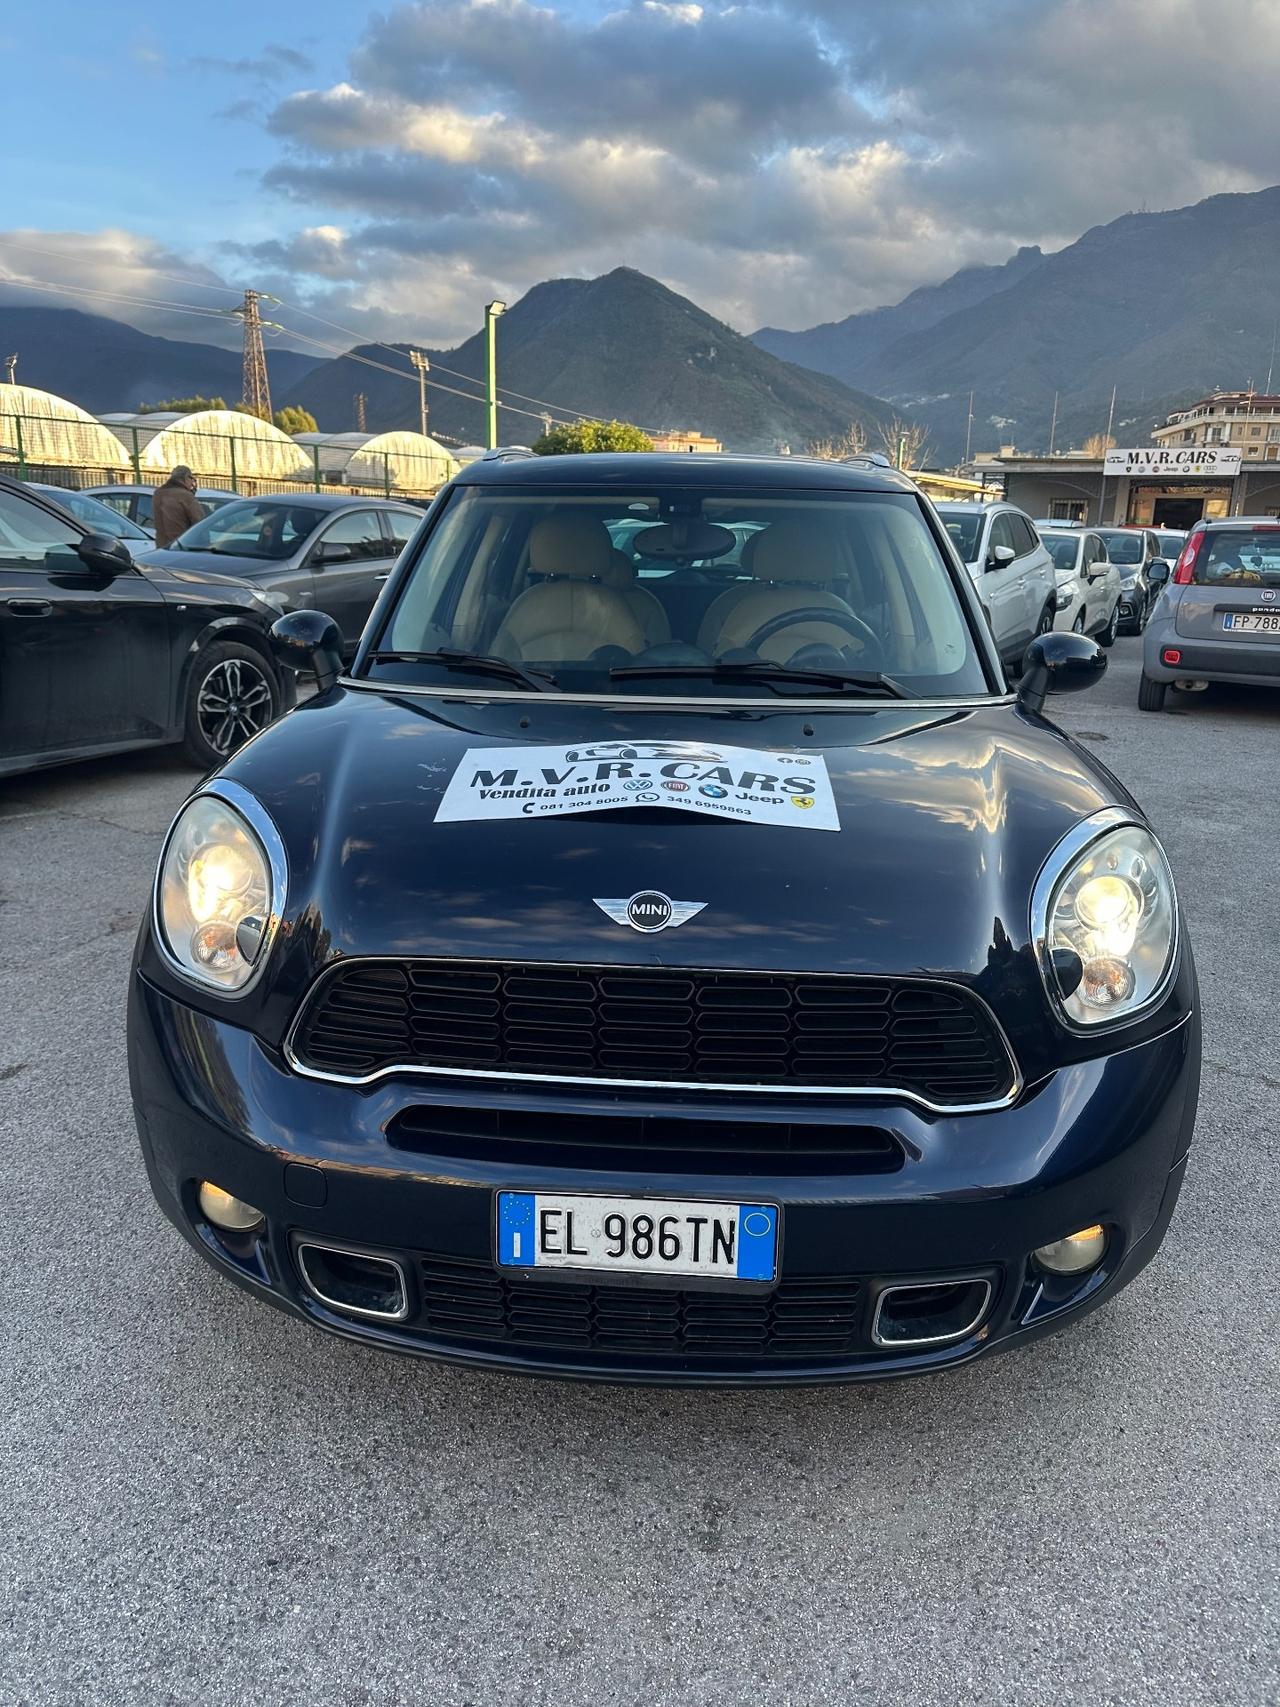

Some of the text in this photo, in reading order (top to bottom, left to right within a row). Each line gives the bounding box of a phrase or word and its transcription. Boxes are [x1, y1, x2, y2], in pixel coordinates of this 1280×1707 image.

[1254, 616, 1280, 630] 788
[479, 783, 611, 800] Vendita auto
[596, 796, 628, 805] 8005
[667, 796, 692, 804] 349
[735, 792, 785, 805] Jeep
[631, 903, 668, 916] MINI
